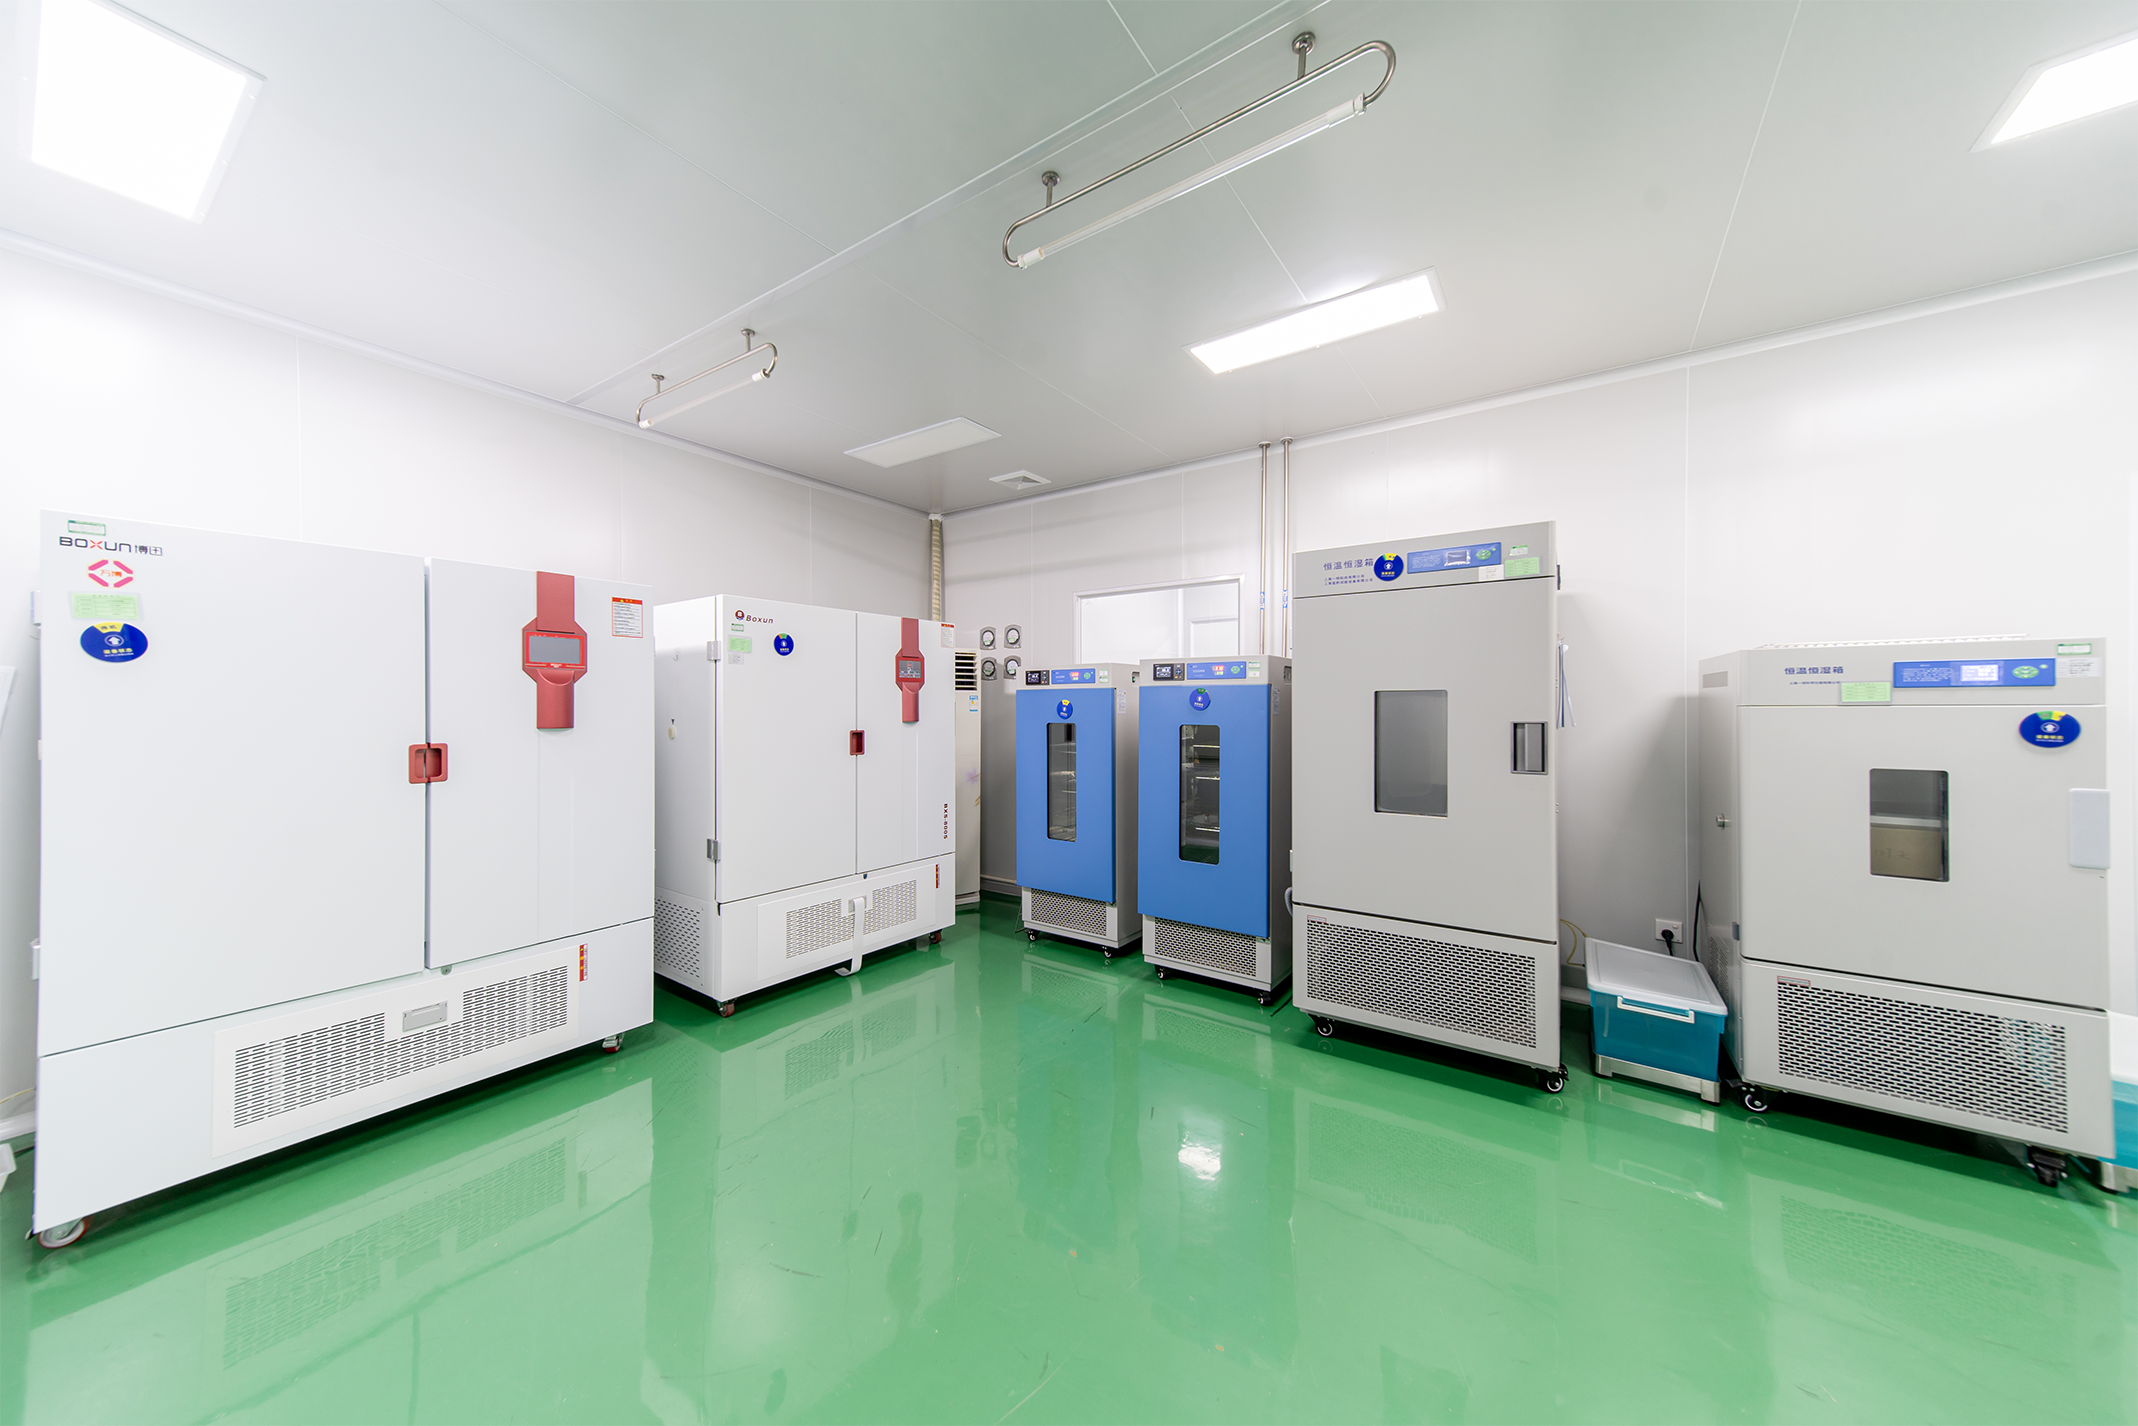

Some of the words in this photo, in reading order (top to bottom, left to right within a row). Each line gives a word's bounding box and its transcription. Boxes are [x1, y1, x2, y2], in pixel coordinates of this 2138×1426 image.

[59, 536, 132, 553] BOXUN
[1323, 558, 1374, 571] 恒温恒湿箱
[746, 615, 774, 624] Boxun
[1784, 666, 1844, 675] 恒温恒湿箱
